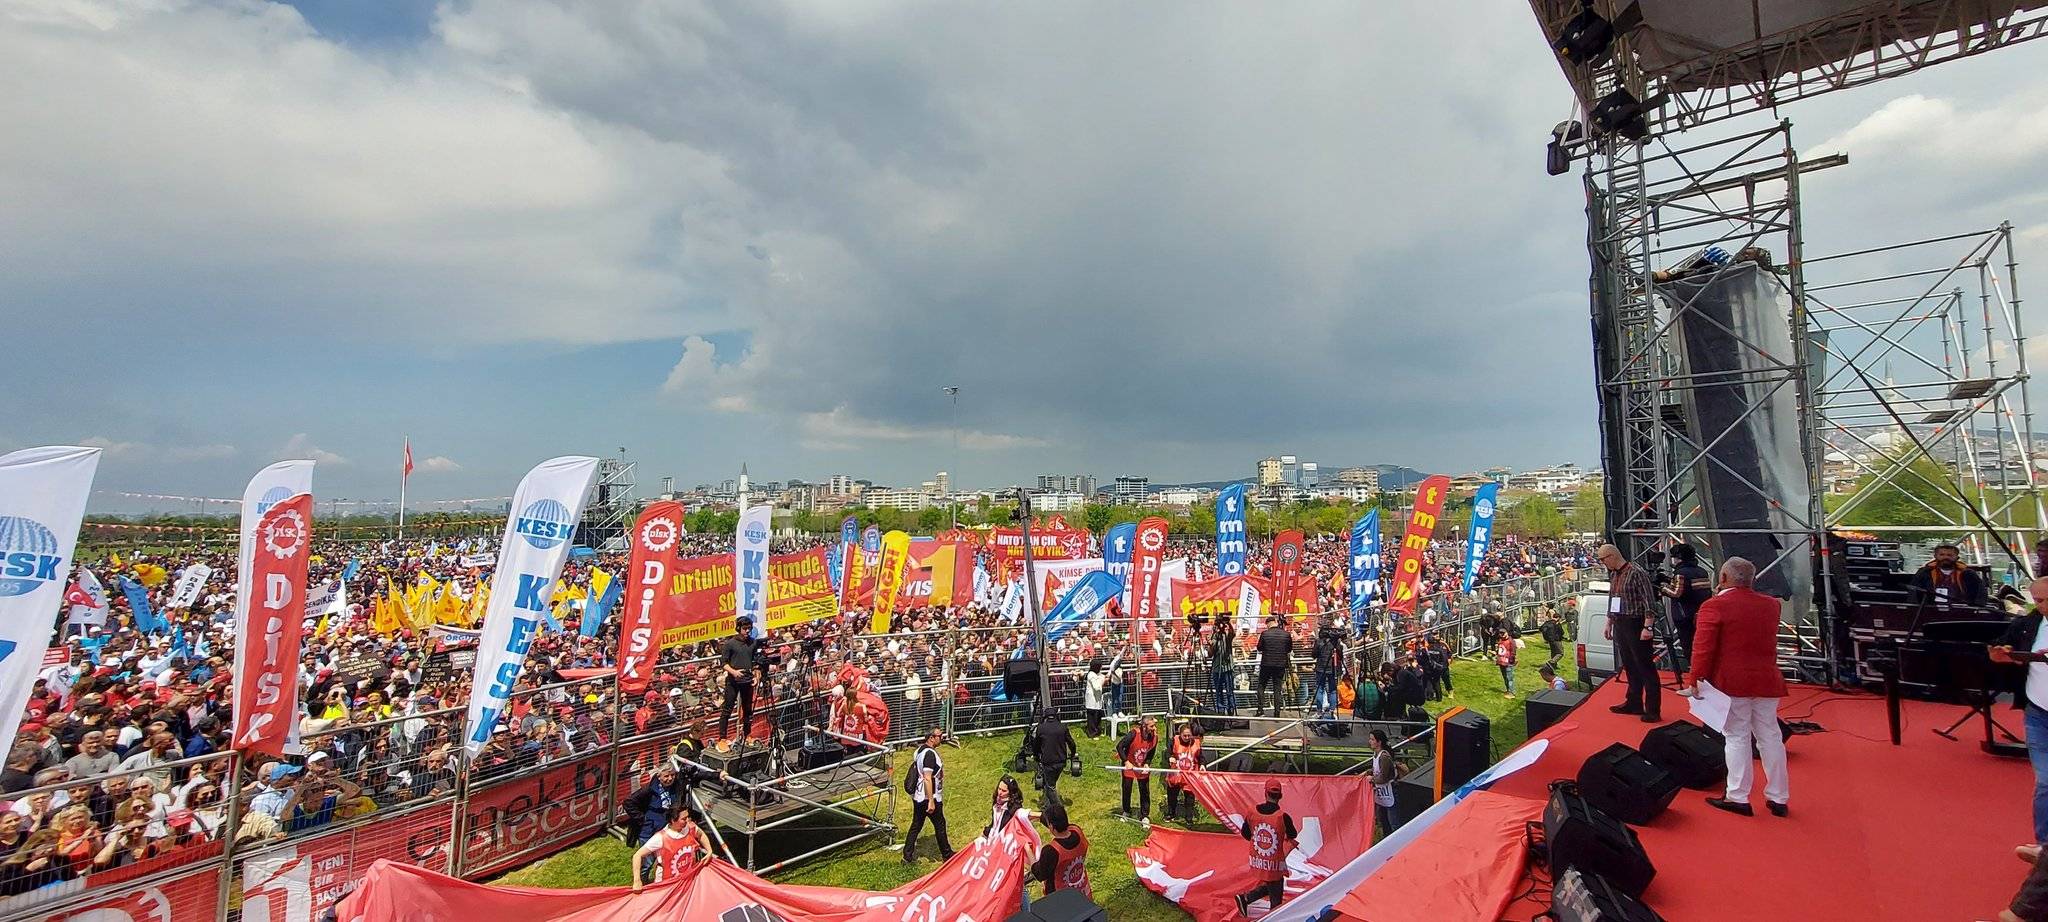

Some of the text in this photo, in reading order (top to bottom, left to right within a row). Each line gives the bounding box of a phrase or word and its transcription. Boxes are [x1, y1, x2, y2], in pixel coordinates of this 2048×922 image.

[516, 517, 575, 540] KESK
[744, 529, 767, 540] KESK
[1218, 495, 1244, 576] tmmo
[669, 564, 733, 596] urtuluş
[905, 580, 933, 597] YIS
[1059, 567, 1083, 578] KİMSE
[1138, 555, 1157, 633] DİSK
[622, 560, 665, 679] DİSK
[766, 608, 786, 622] rteji
[238, 572, 294, 746] DİSK
[471, 573, 549, 743] KESK
